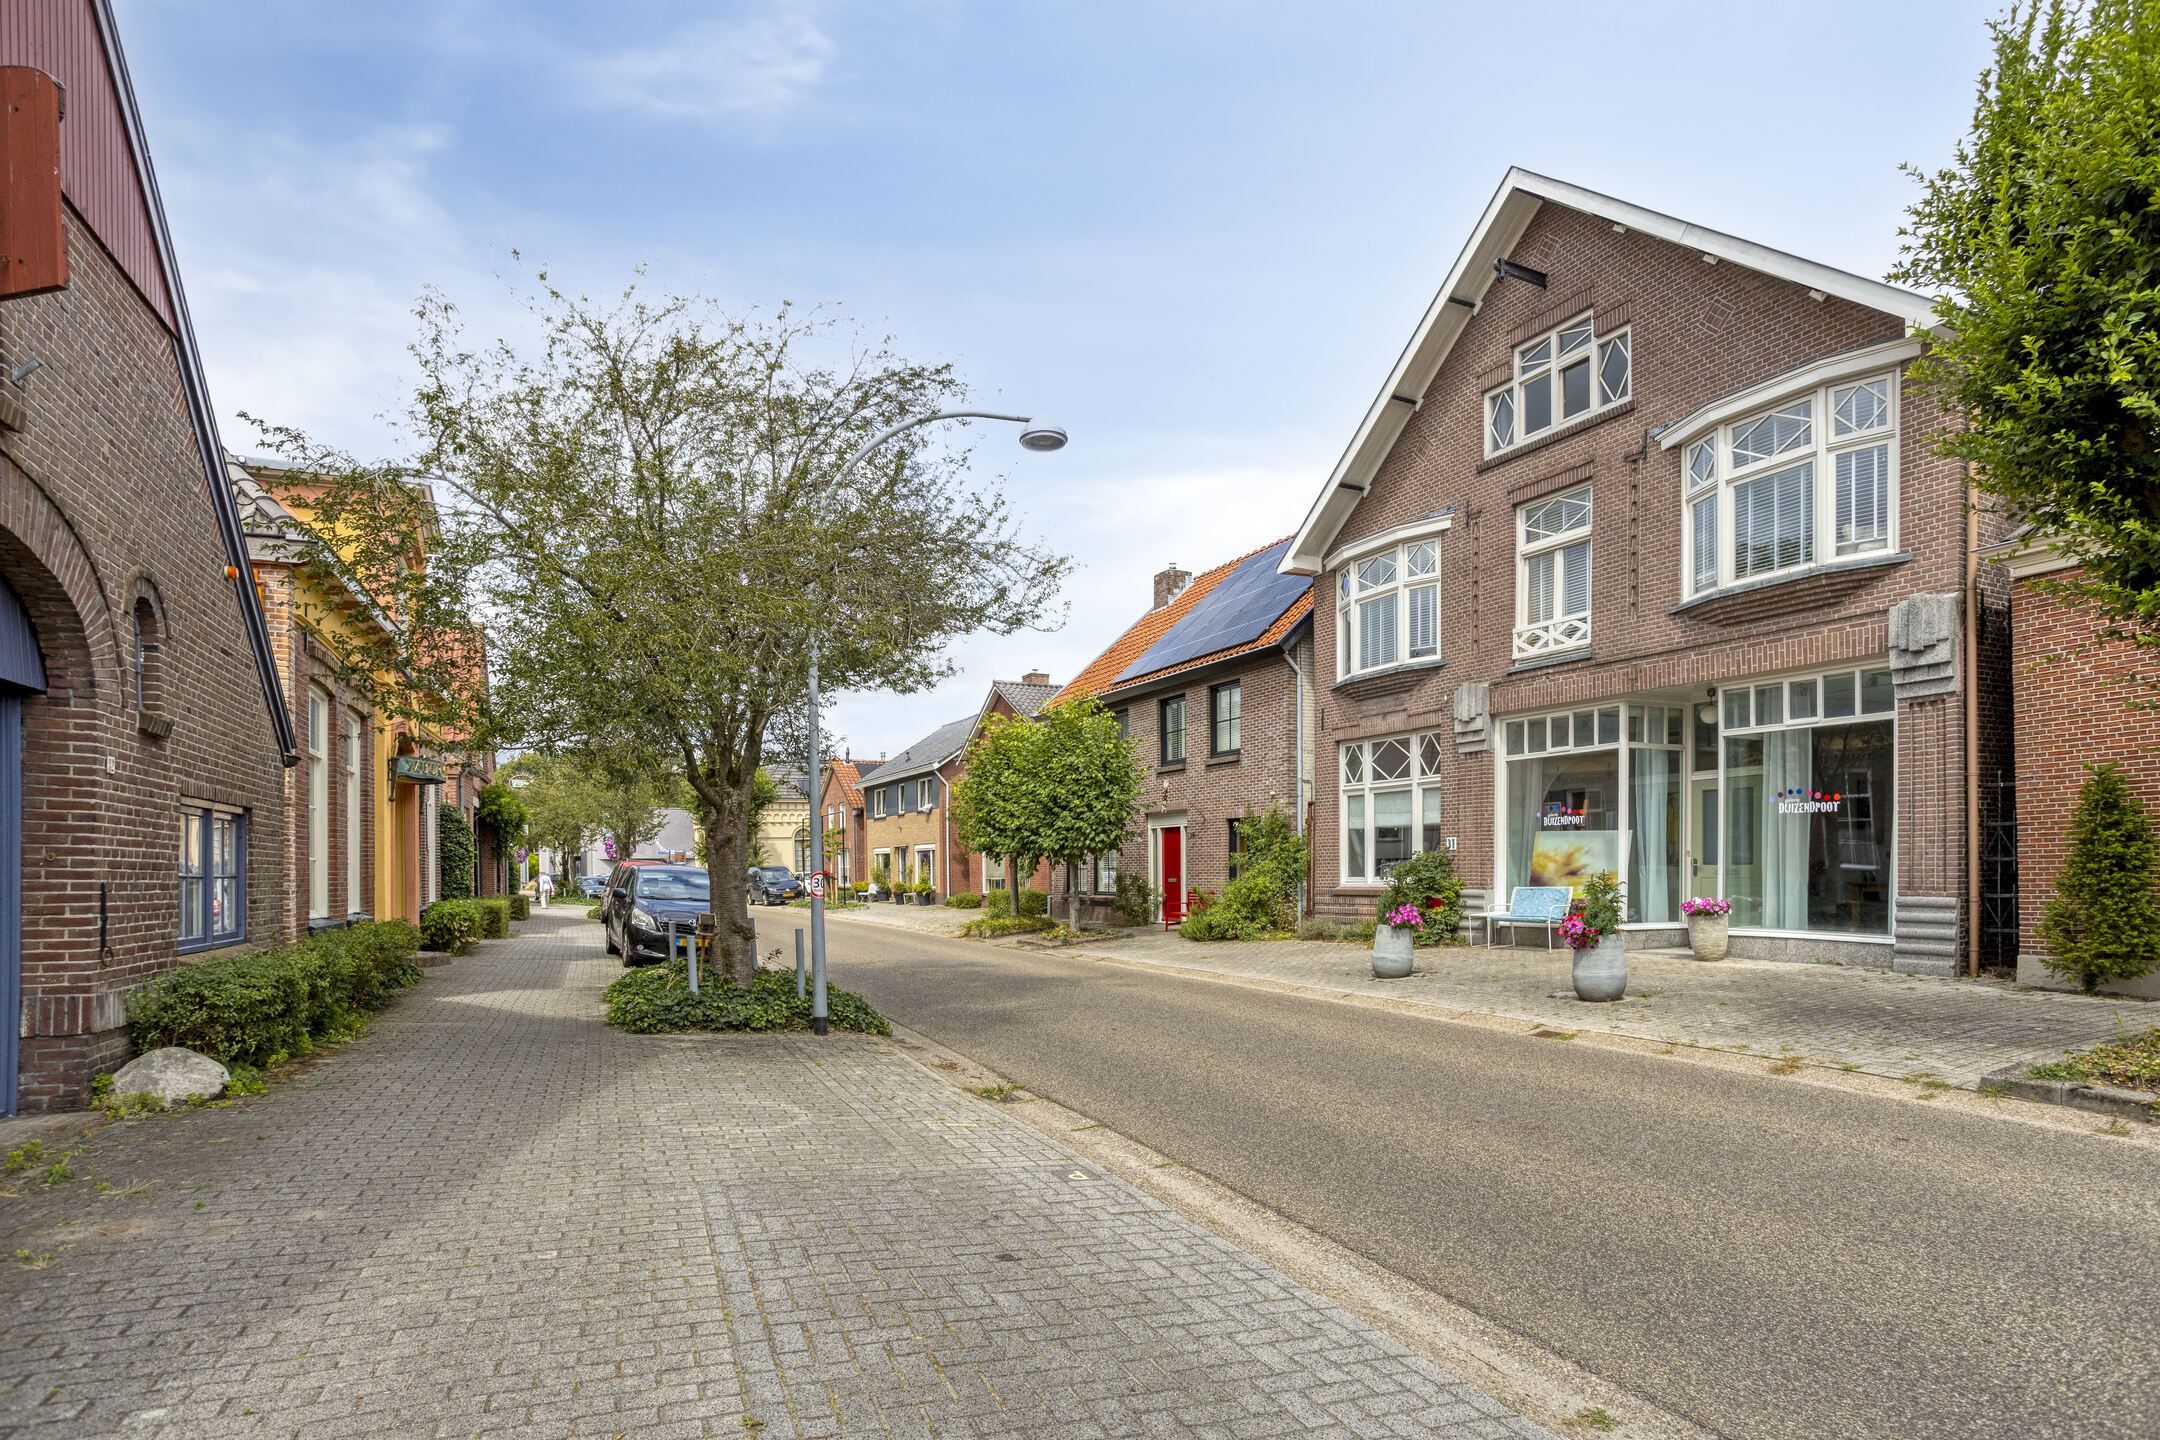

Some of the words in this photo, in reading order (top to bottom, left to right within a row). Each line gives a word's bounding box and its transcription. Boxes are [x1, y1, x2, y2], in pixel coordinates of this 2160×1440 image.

[1778, 801, 1841, 814] DUIZENDPOOT
[1543, 815, 1585, 826] DUIZENDPOOT
[1447, 838, 1456, 850] 31
[813, 877, 824, 889] 30
